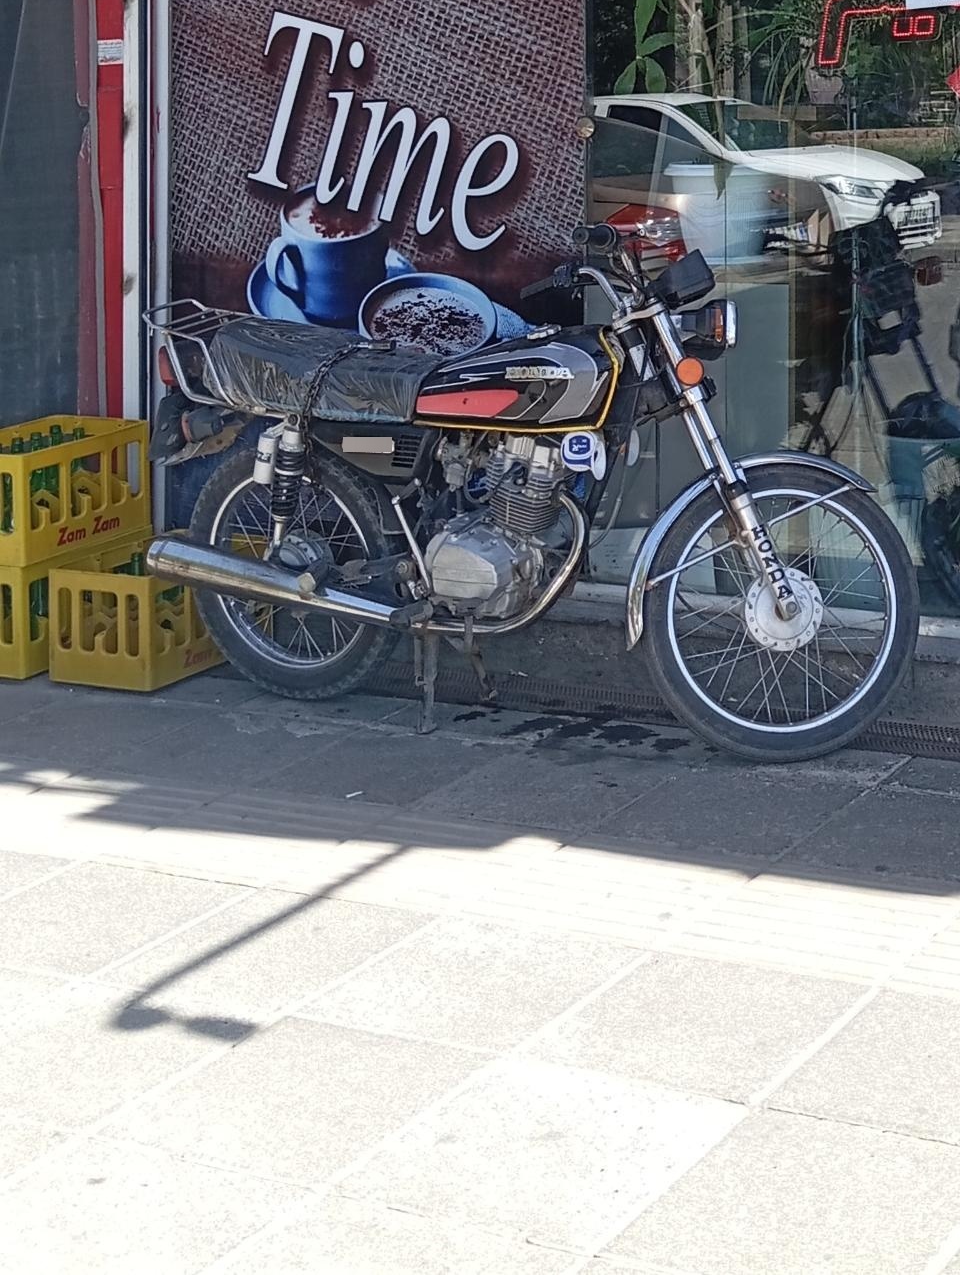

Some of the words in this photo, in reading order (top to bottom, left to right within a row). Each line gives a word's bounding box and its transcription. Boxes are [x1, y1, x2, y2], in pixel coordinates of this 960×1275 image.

[246, 12, 519, 251] Time
[57, 526, 87, 546] Zam
[92, 515, 120, 535] Zam
[752, 524, 793, 599] HONDA
